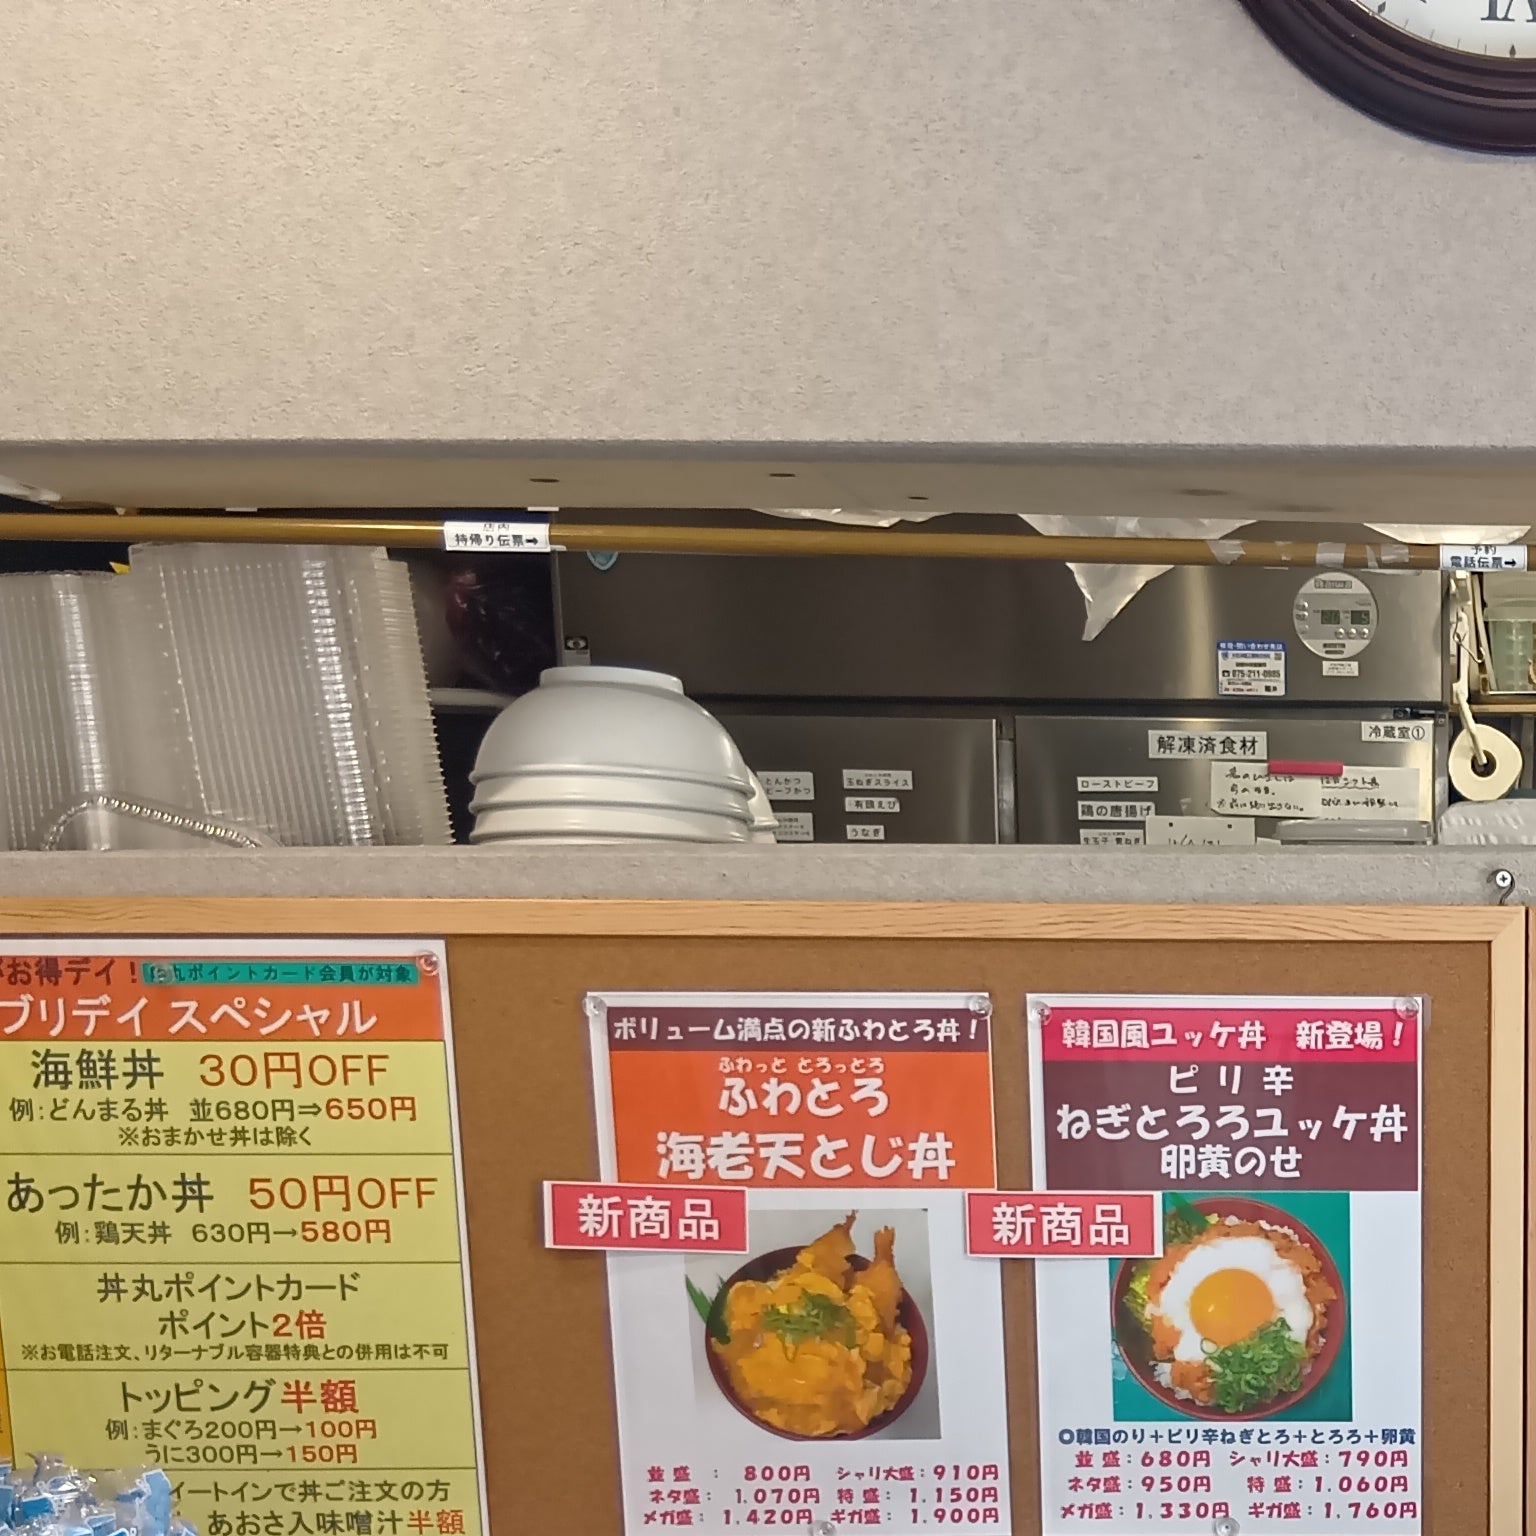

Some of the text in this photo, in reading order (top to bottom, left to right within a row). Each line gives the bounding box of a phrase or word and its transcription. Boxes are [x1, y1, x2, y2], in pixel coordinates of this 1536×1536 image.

[1157, 736, 1258, 755] 解凍済食材
[1081, 780, 1155, 789] ローストビーフ
[168, 997, 378, 1035] スペシャル
[1062, 1019, 1267, 1050] 韓国風ユッケ丼
[31, 1048, 390, 1091] 海鮮丼 30円OFF
[718, 1057, 885, 1073] ふわっと とろっとろ
[1169, 1064, 1294, 1096] ピリ辛
[718, 1077, 889, 1117] ふわとろ
[118, 1126, 312, 1147] ※おまかせ丼は除く
[1057, 1104, 1408, 1144] ねぎとろろユッケ丼
[656, 1130, 956, 1181] 海老天とじ丼
[1161, 1144, 1303, 1179] 卵黄のせ
[6, 1171, 438, 1213] あったか丼 50円OFF
[578, 1195, 720, 1242] 新商品
[992, 1203, 1130, 1247] 新商品
[97, 1272, 361, 1303] 丼丸ポイントカード
[158, 1309, 327, 1341] ポイント2倍
[121, 1379, 359, 1414] トッピング半額
[208, 1509, 466, 1536] あおさ入味噌汁半額
